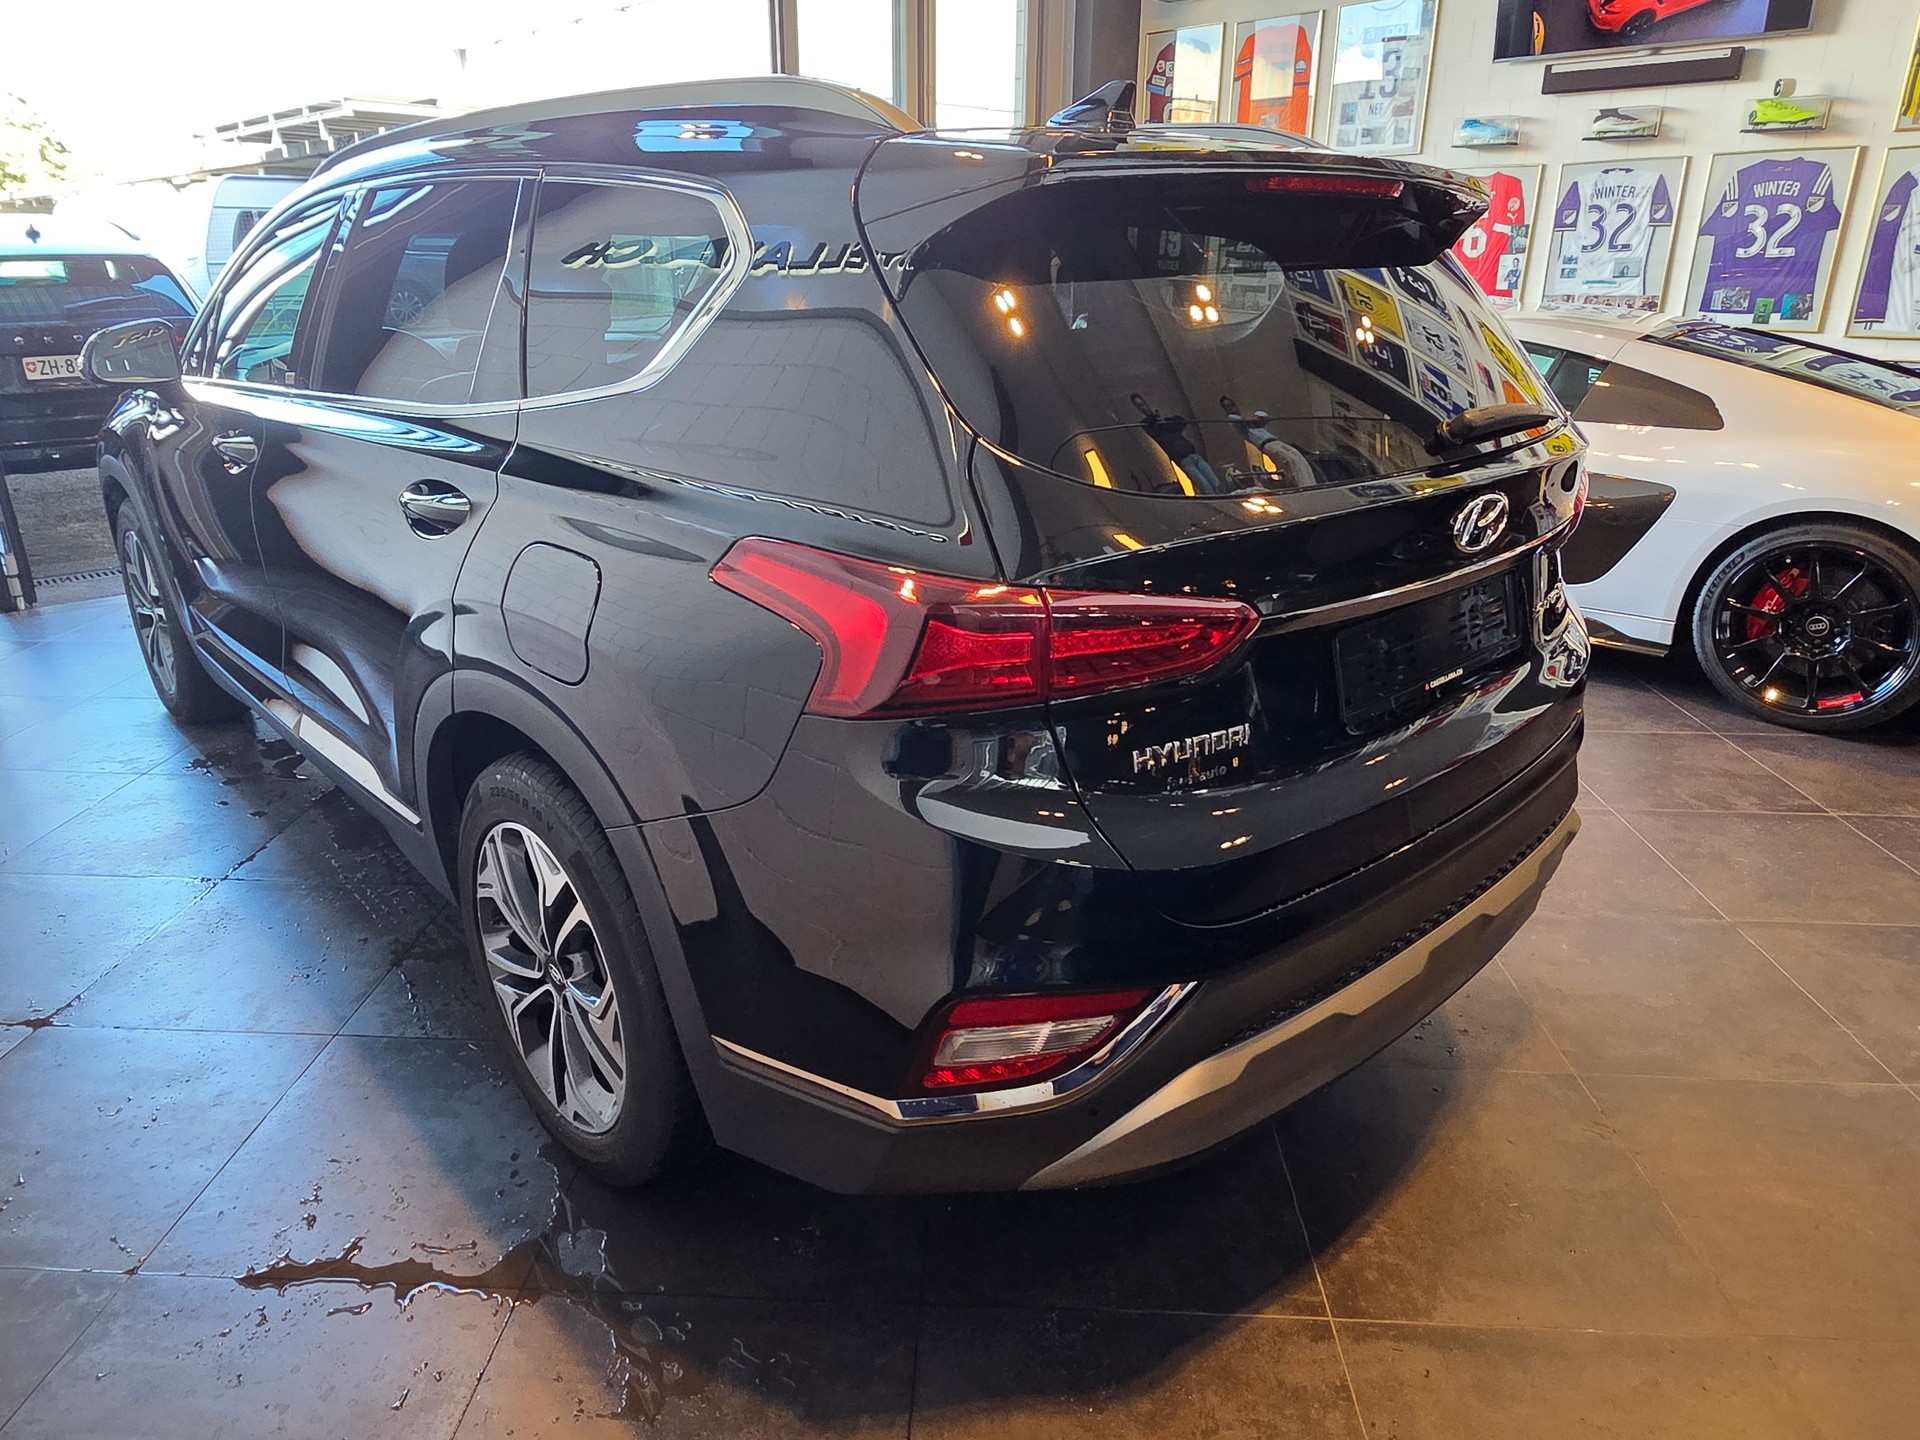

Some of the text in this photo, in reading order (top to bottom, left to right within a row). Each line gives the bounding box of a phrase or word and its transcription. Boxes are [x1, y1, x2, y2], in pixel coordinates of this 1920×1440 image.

[1368, 103, 1384, 115] NEF
[1594, 184, 1637, 200] WINTER
[1753, 180, 1801, 198] WINTER
[1580, 203, 1637, 253] 32
[1734, 202, 1802, 259] 32
[1132, 723, 1250, 773] HYUNDAI
